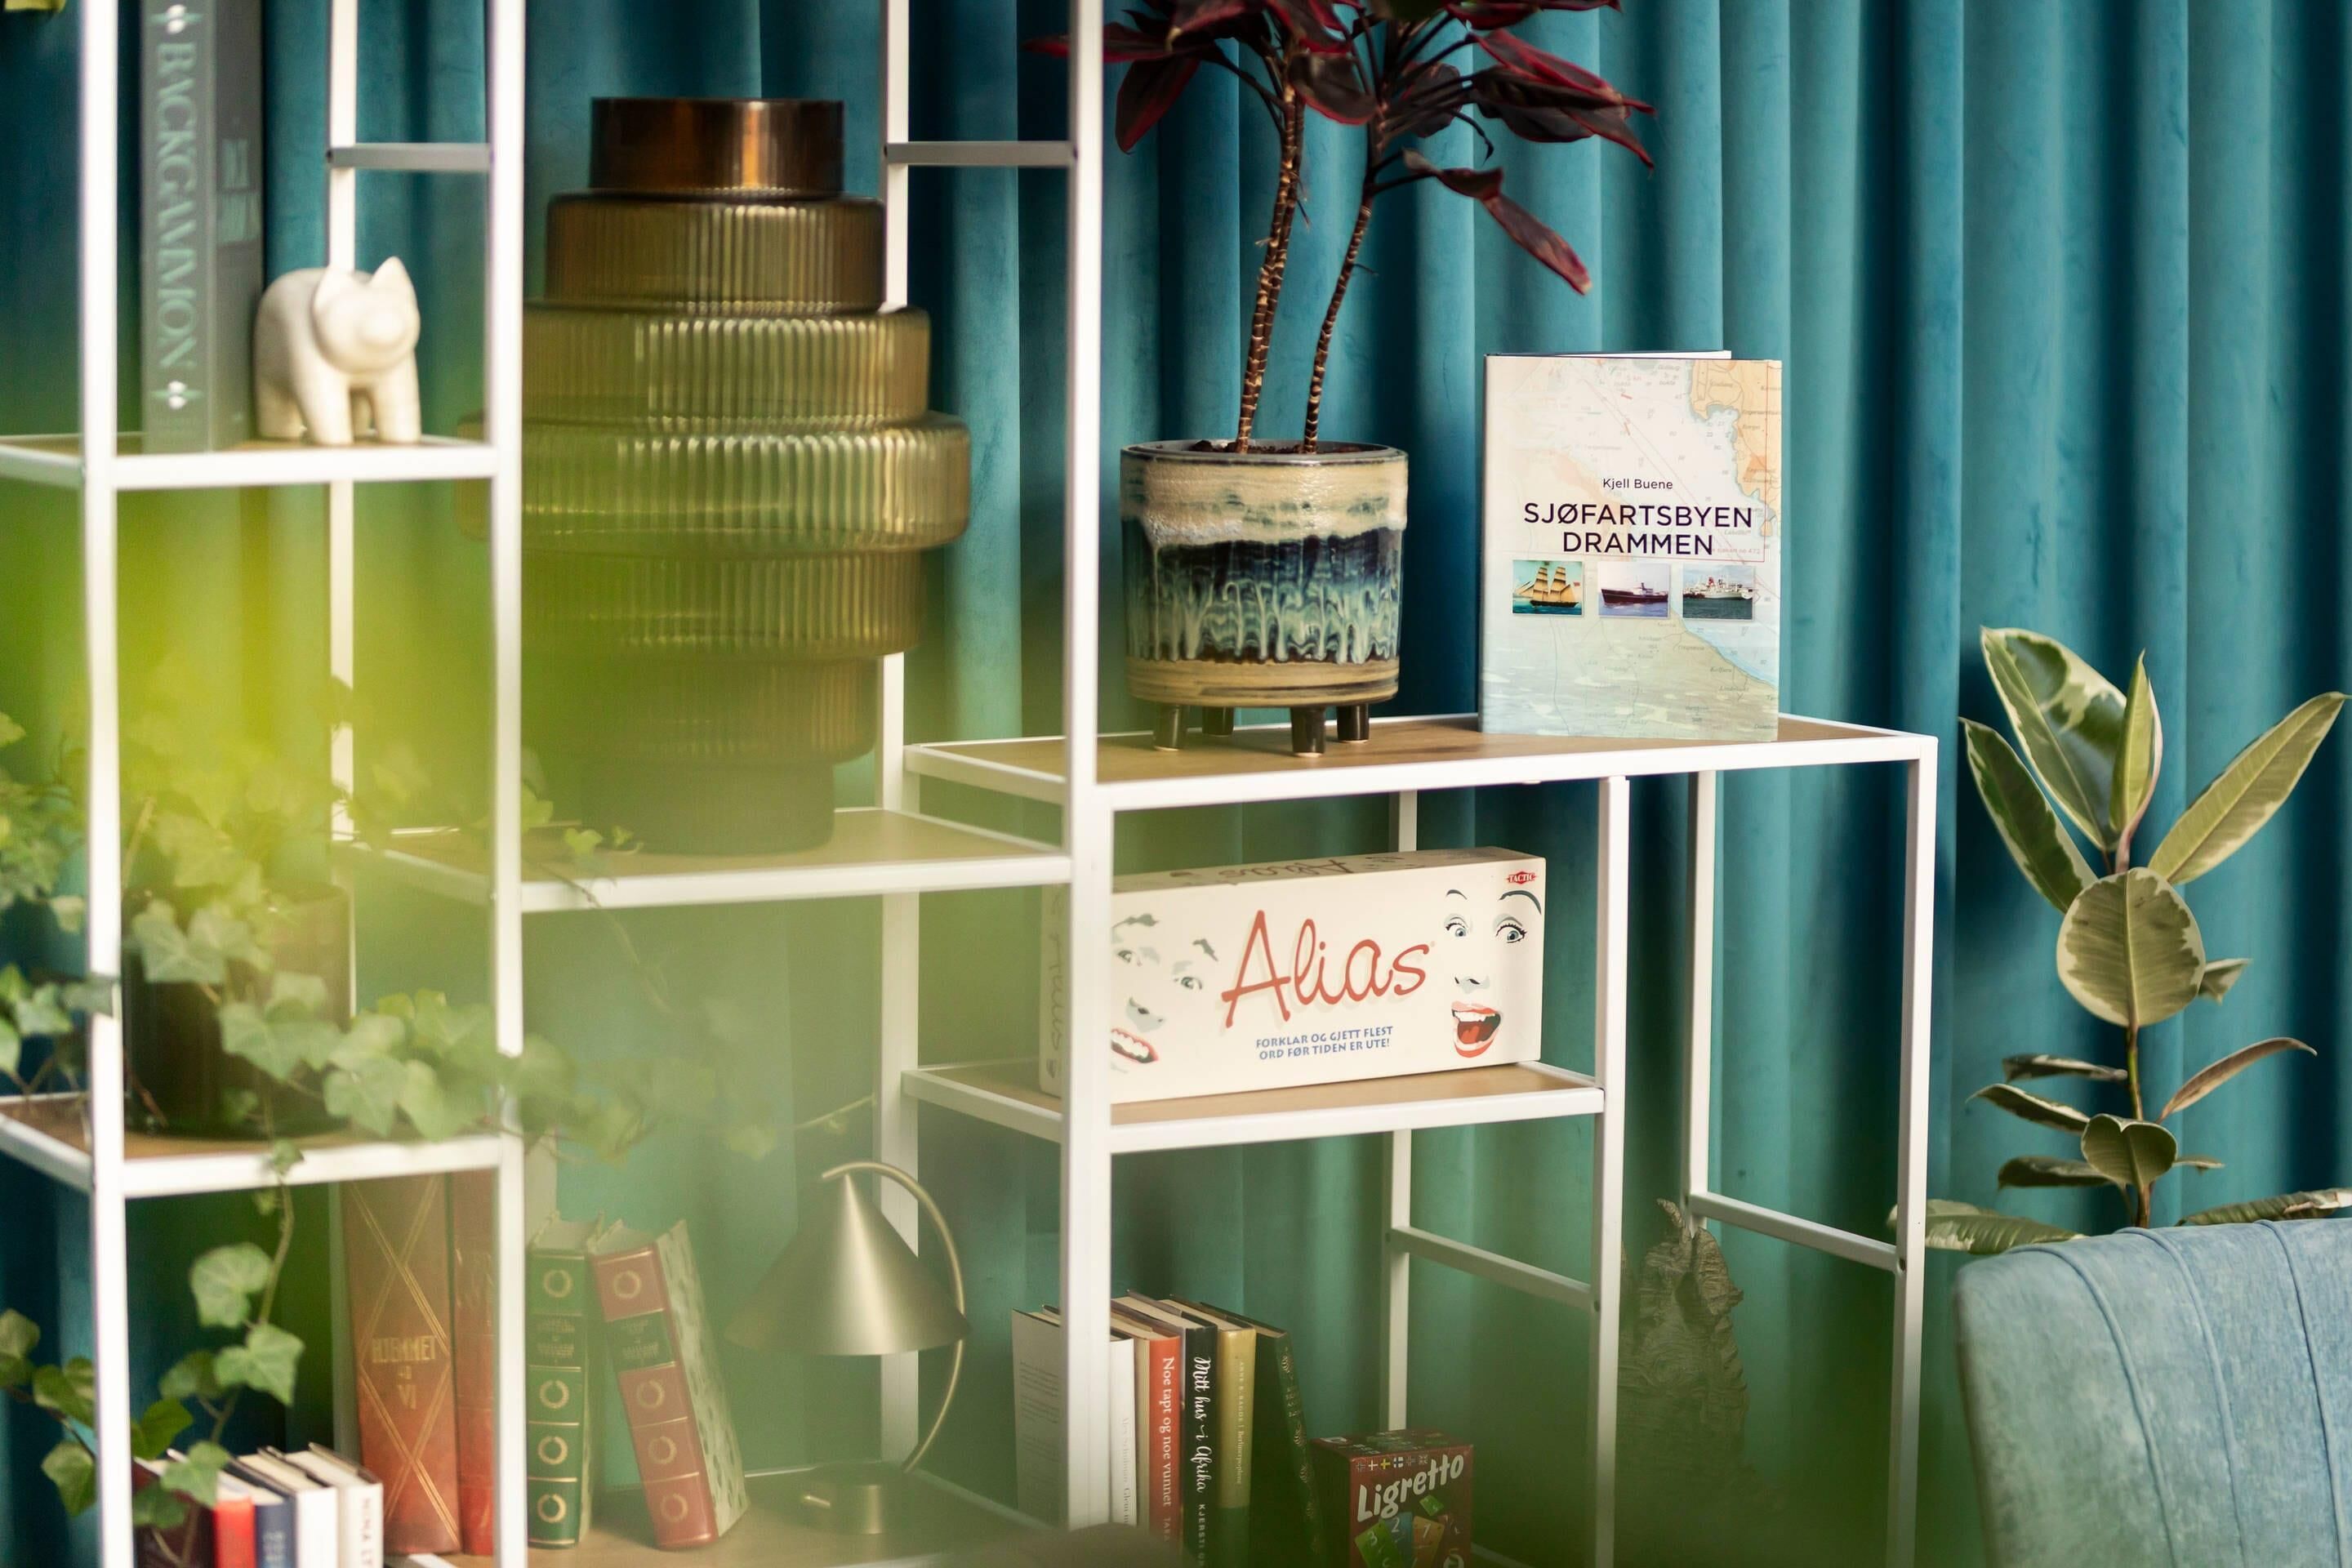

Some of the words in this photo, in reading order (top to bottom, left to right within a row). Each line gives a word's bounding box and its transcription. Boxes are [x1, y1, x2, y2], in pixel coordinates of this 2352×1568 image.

[156, 42, 198, 370] BACKGAMMON
[1603, 479, 1629, 490] Kjell
[1634, 479, 1673, 489] Buene
[1524, 502, 1752, 528] SJØFARTSBYEN
[1563, 532, 1713, 555] DRAMMEN
[1508, 873, 1535, 883] TACTIC
[1222, 910, 1430, 1028] Alias
[1256, 1035, 1308, 1049] FORKLAR
[1311, 1032, 1327, 1043] OG
[1330, 1029, 1361, 1041] GJETT
[1364, 1026, 1393, 1037] FLEST
[1259, 1049, 1284, 1060] ORD
[1287, 1046, 1310, 1058] FØR
[1312, 1043, 1347, 1055] TIDEN
[1350, 1040, 1363, 1051] ER
[1365, 1038, 1390, 1049] UTE!
[1163, 1356, 1175, 1385] Noe
[1192, 1356, 1211, 1392] Mitt
[1159, 1388, 1172, 1414] tapt
[1194, 1394, 1211, 1420] hus
[1159, 1416, 1172, 1434] og
[1162, 1436, 1172, 1459] noe
[1190, 1446, 1213, 1494] Afrika
[1162, 1461, 1172, 1507] vunnet
[1357, 1454, 1464, 1522] Ligretto
[1198, 1503, 1206, 1548] KJERSTI
